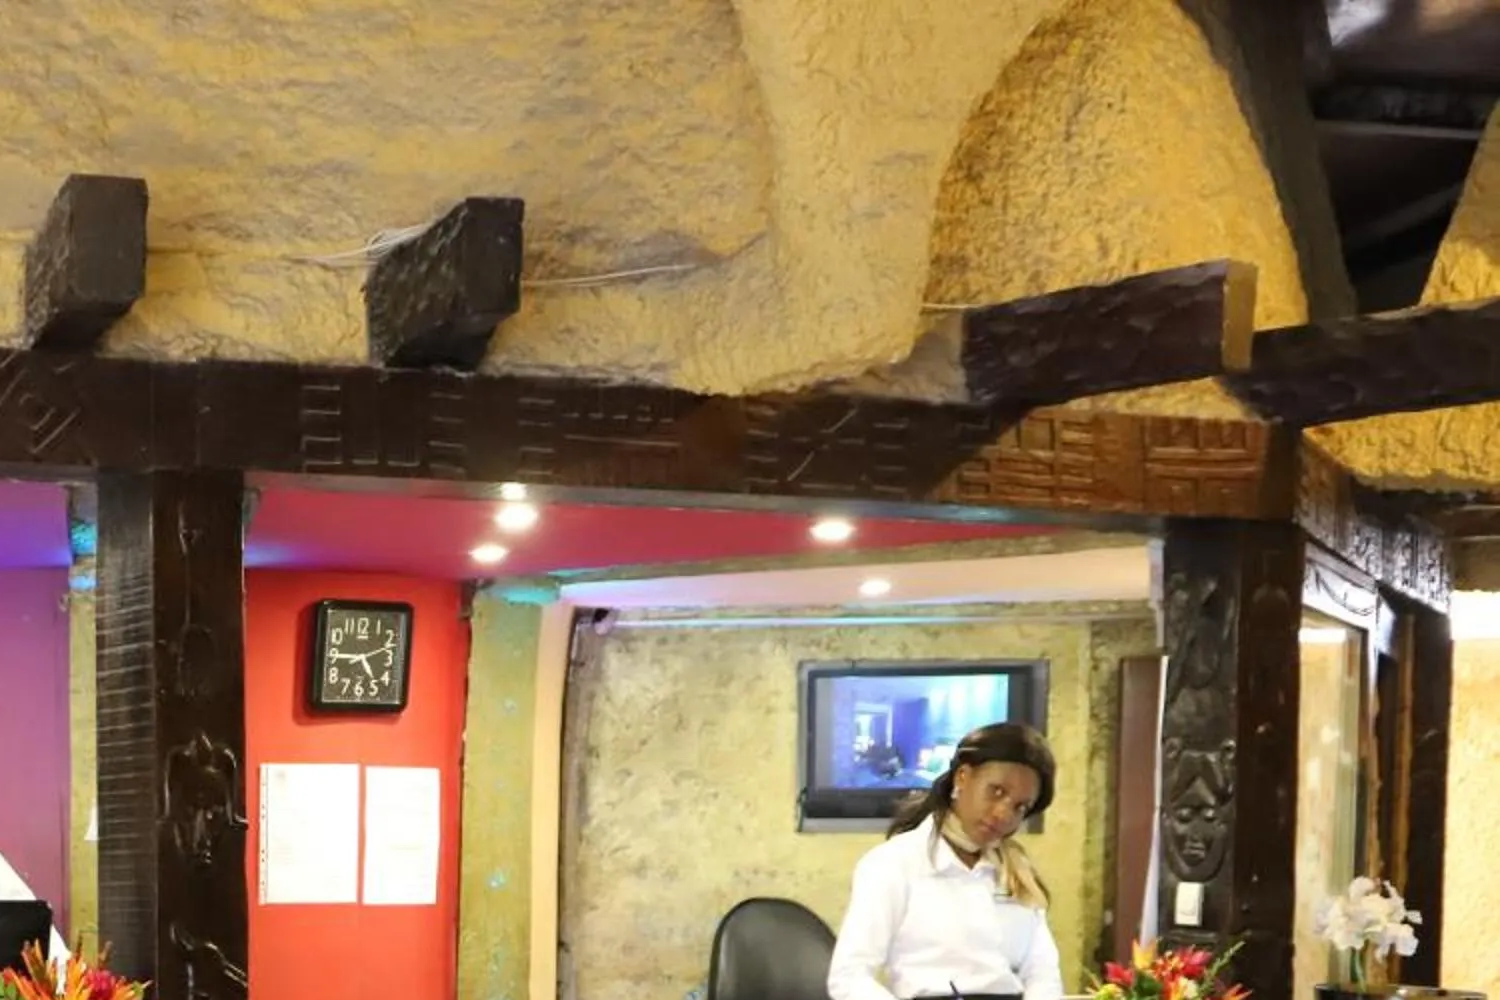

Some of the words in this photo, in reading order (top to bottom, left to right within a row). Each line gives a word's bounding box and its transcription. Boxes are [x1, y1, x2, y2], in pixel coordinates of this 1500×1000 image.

[344, 617, 355, 635] 11
[357, 617, 369, 634] 12
[375, 619, 382, 635] 1
[331, 627, 343, 645] 10
[384, 629, 397, 647] 2
[329, 648, 340, 664] 9
[384, 649, 393, 667] 3
[328, 667, 338, 684] 8
[380, 671, 390, 686] 4
[340, 677, 350, 695] 7
[354, 678, 364, 696] 6
[368, 679, 379, 697] 5
